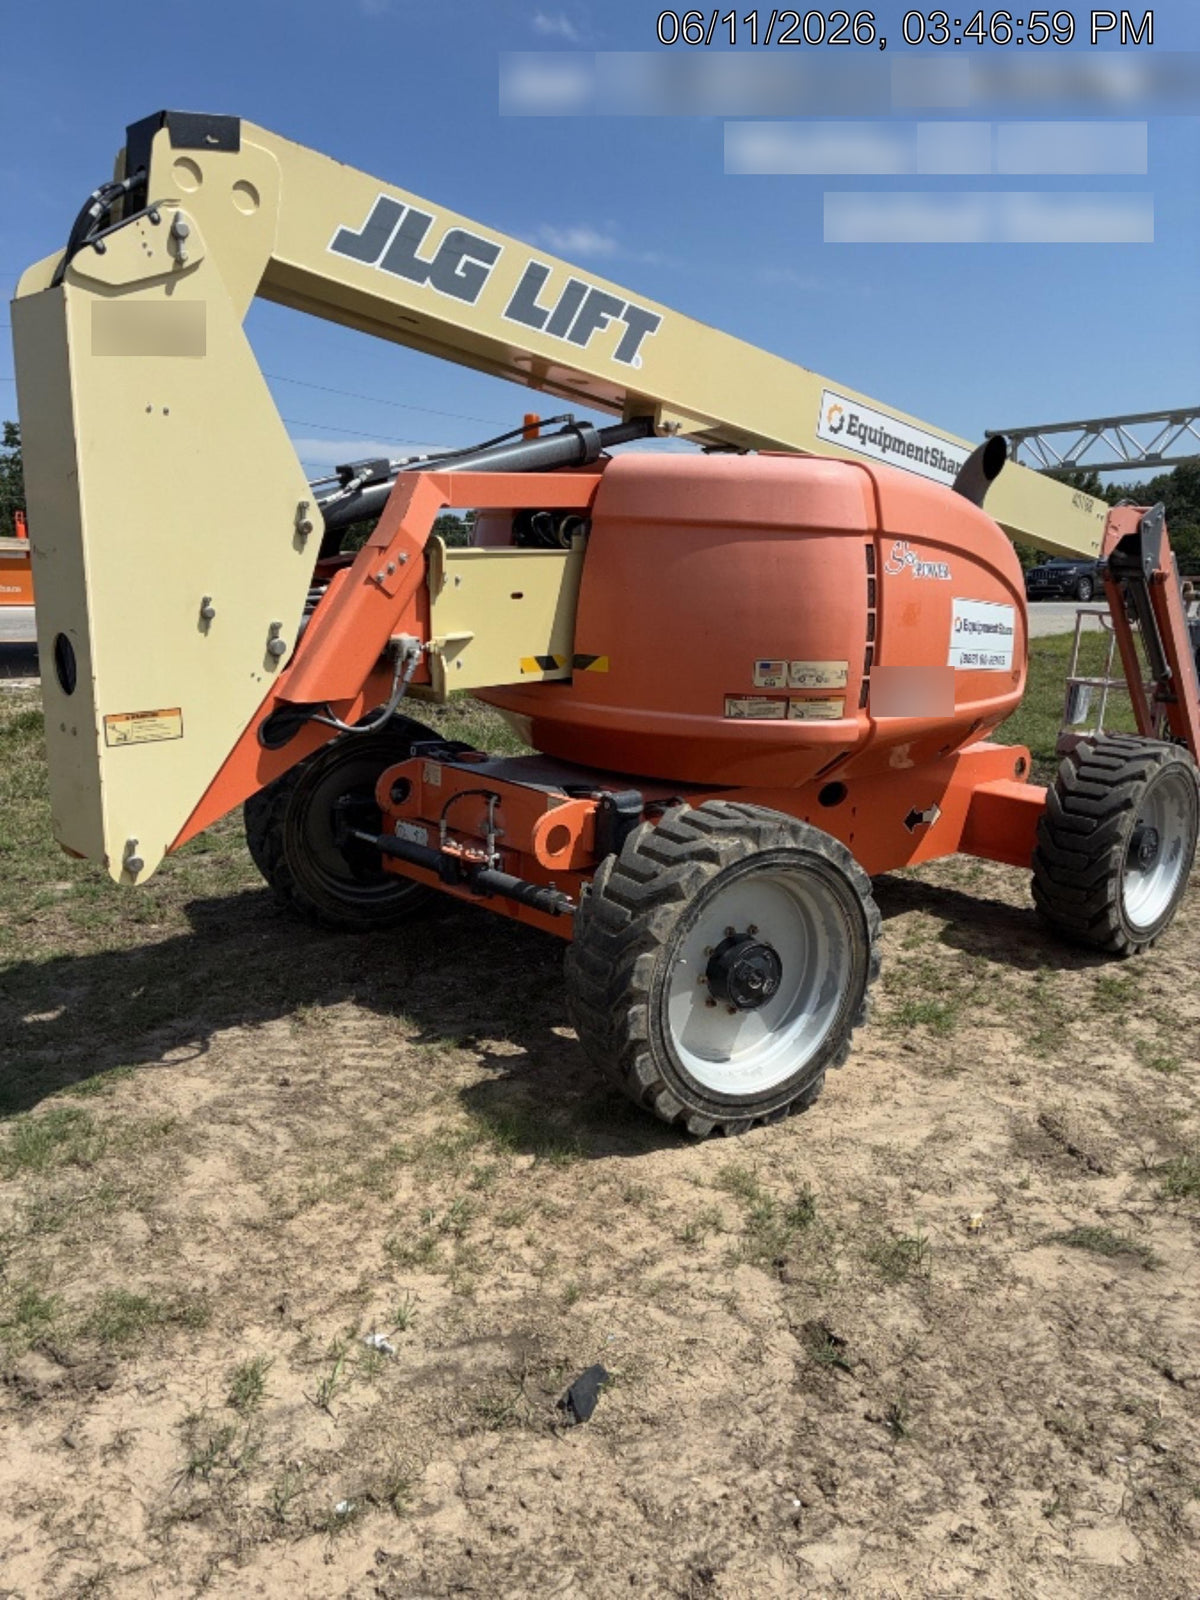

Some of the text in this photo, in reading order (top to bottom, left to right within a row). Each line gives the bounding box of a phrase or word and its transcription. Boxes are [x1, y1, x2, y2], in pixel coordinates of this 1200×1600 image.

[328, 193, 663, 364] JLG LIFT
[846, 414, 963, 475] EquipmentShar
